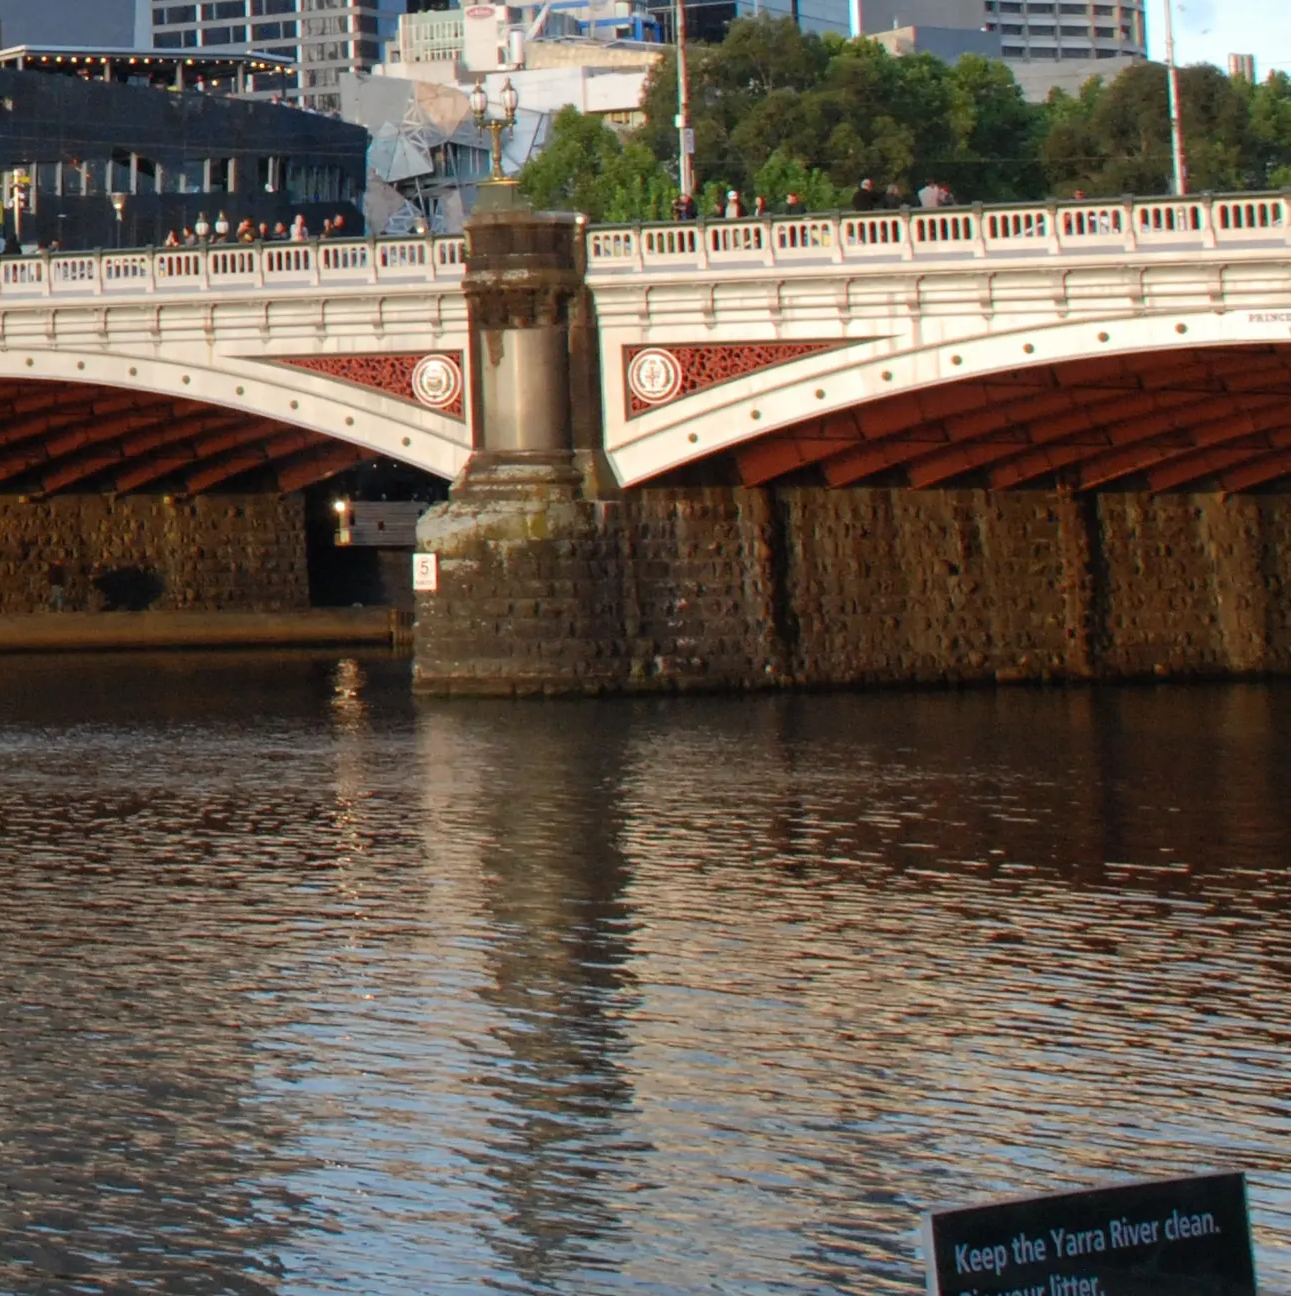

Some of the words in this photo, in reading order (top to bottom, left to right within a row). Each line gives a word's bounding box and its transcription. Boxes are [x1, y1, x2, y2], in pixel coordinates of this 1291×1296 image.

[420, 560, 429, 575] 5
[954, 1243, 1007, 1275] Keep
[1011, 1232, 1047, 1265] the
[1051, 1228, 1105, 1258] Yarra
[1111, 1216, 1159, 1249] River
[1164, 1209, 1221, 1241] clean.
